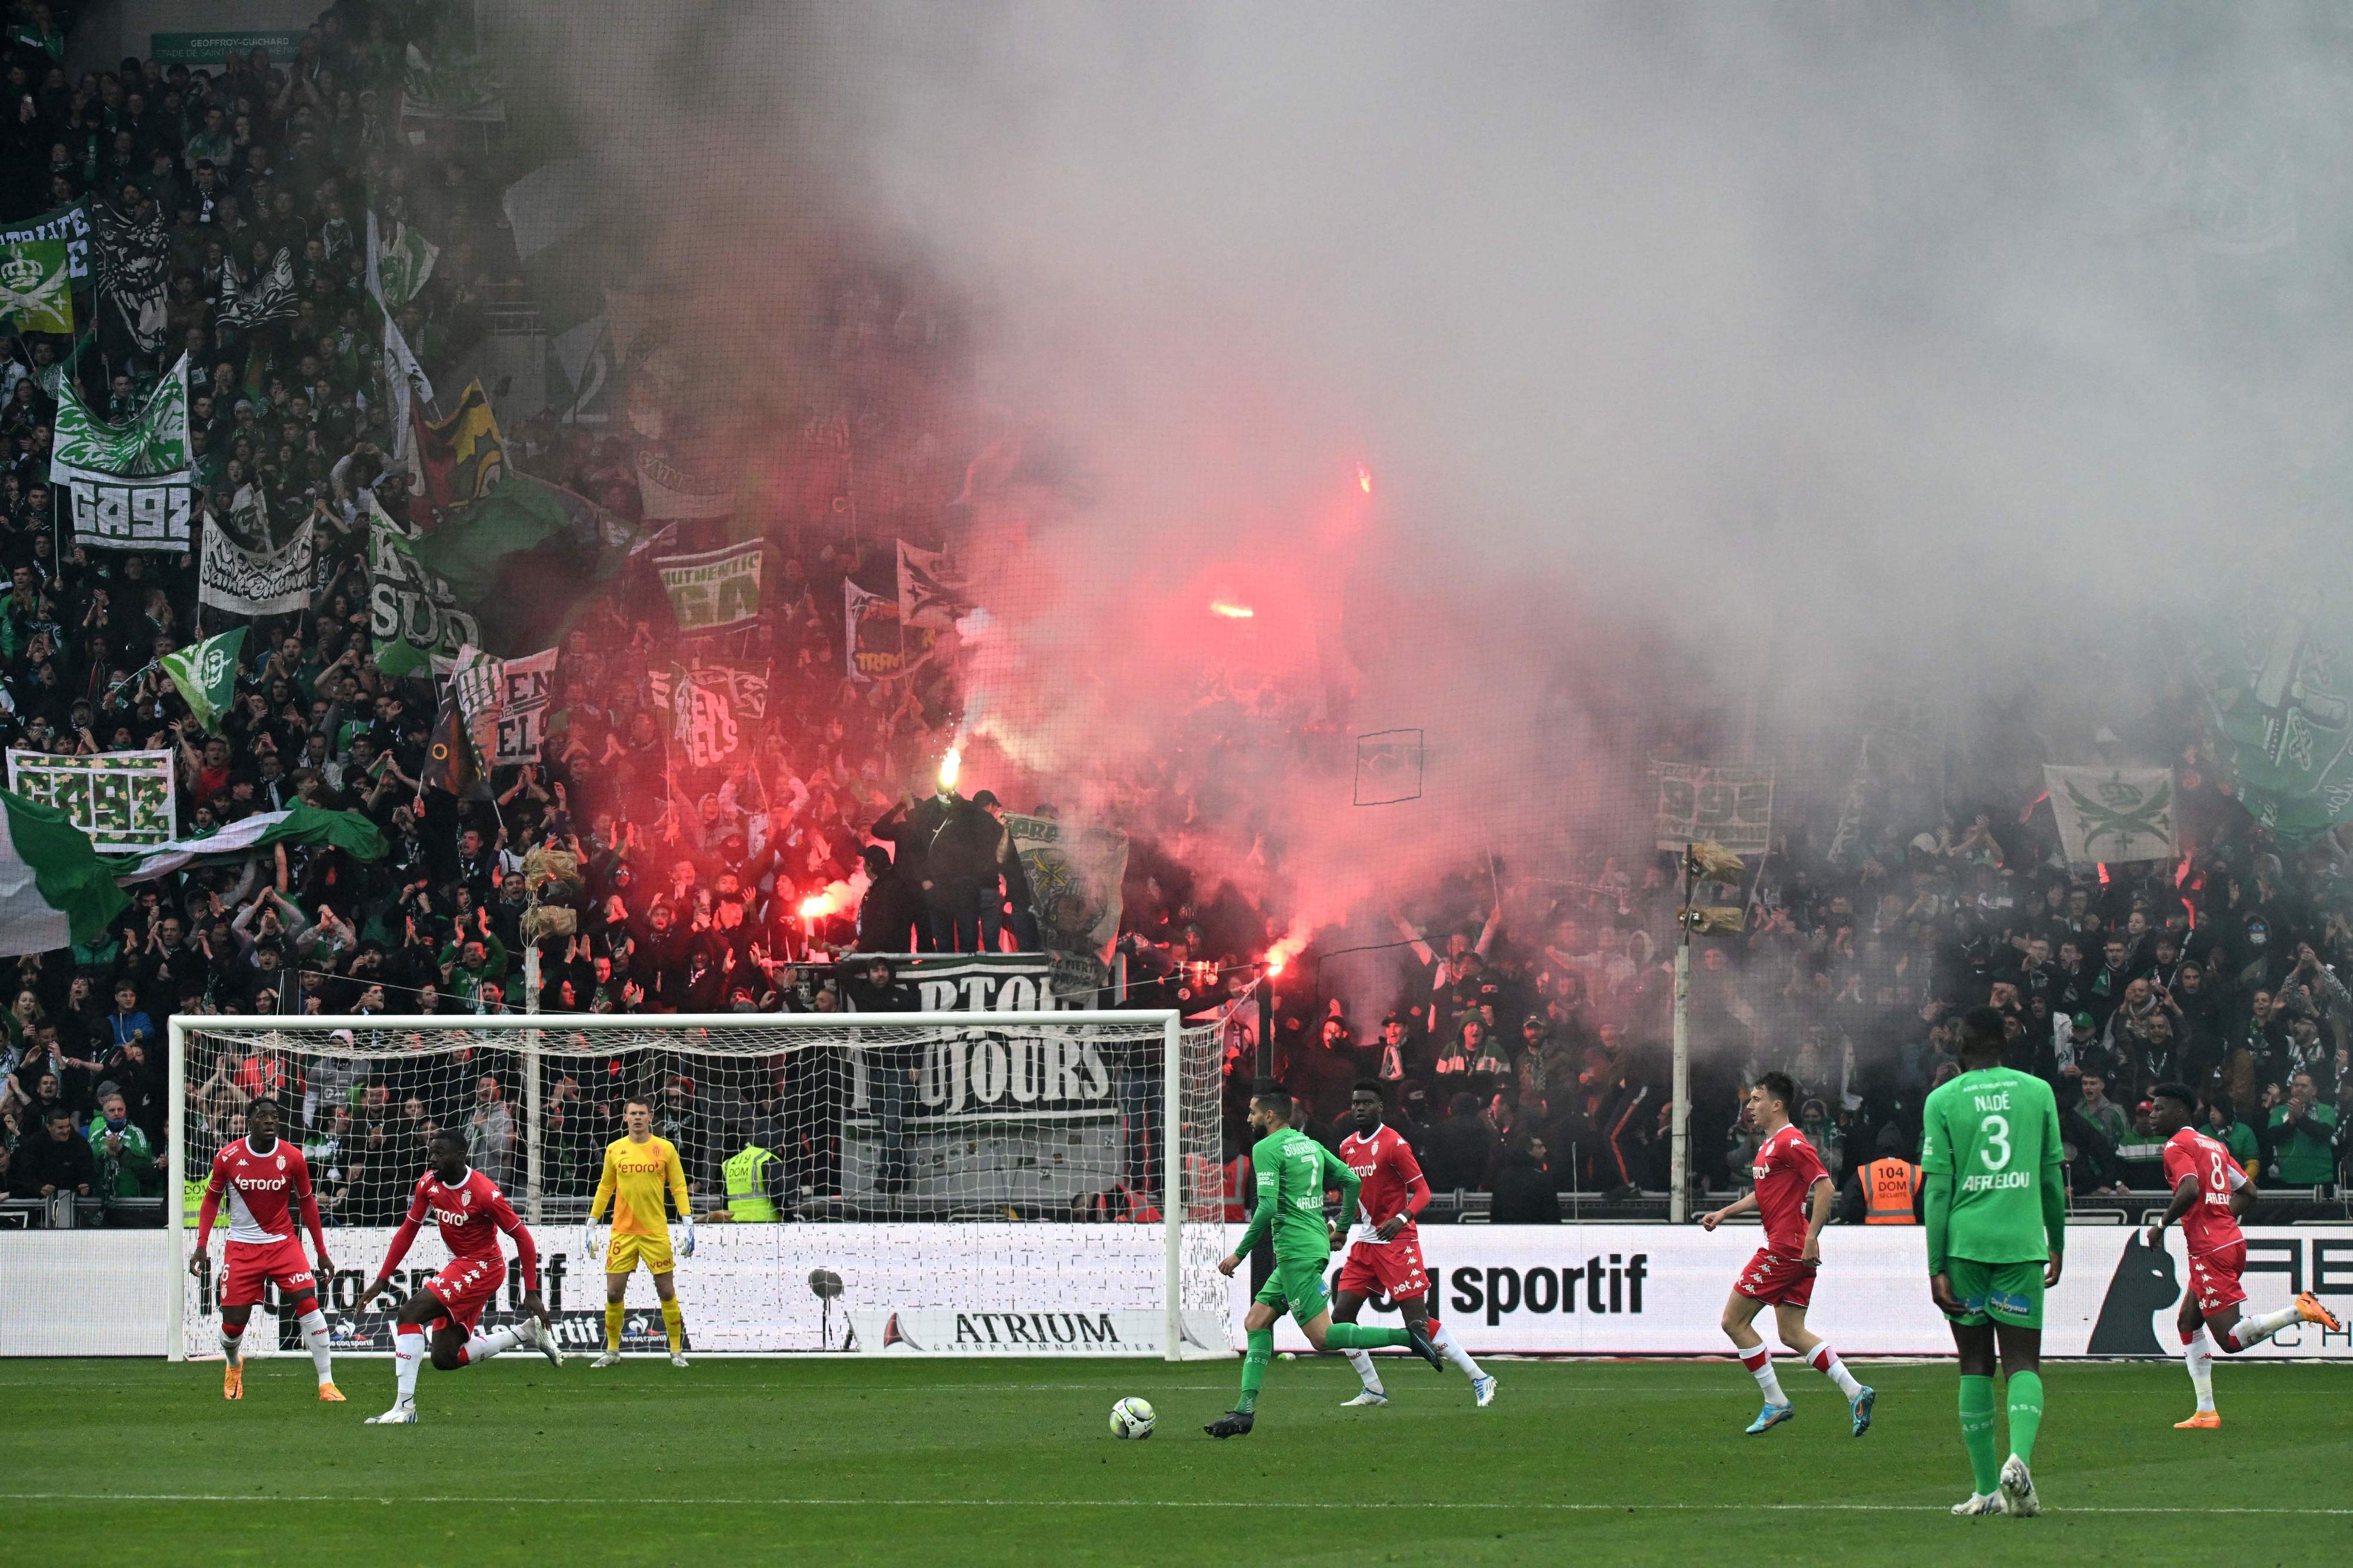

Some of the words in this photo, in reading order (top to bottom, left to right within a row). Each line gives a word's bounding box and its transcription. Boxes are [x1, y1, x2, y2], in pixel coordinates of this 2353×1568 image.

[191, 37, 289, 47] GEOFFROY-GUICHARD
[156, 49, 184, 58] STADE
[186, 49, 198, 57] DE
[1974, 1090, 2011, 1112] NADÉ
[1980, 1115, 2011, 1170] 3
[729, 1167, 749, 1177] DOM
[1301, 1153, 1319, 1196] 7
[1878, 1167, 1904, 1179] 104
[2211, 1152, 2225, 1190] 8
[1878, 1180, 1907, 1192] DOM
[608, 1239, 622, 1255] 16
[221, 1263, 231, 1282] 6
[1451, 1253, 1647, 1326] sportif
[955, 1313, 1121, 1345] ATRIUM
[934, 1344, 1009, 1352] GROUPE
[1026, 1343, 1156, 1352] IMMOBILIER
